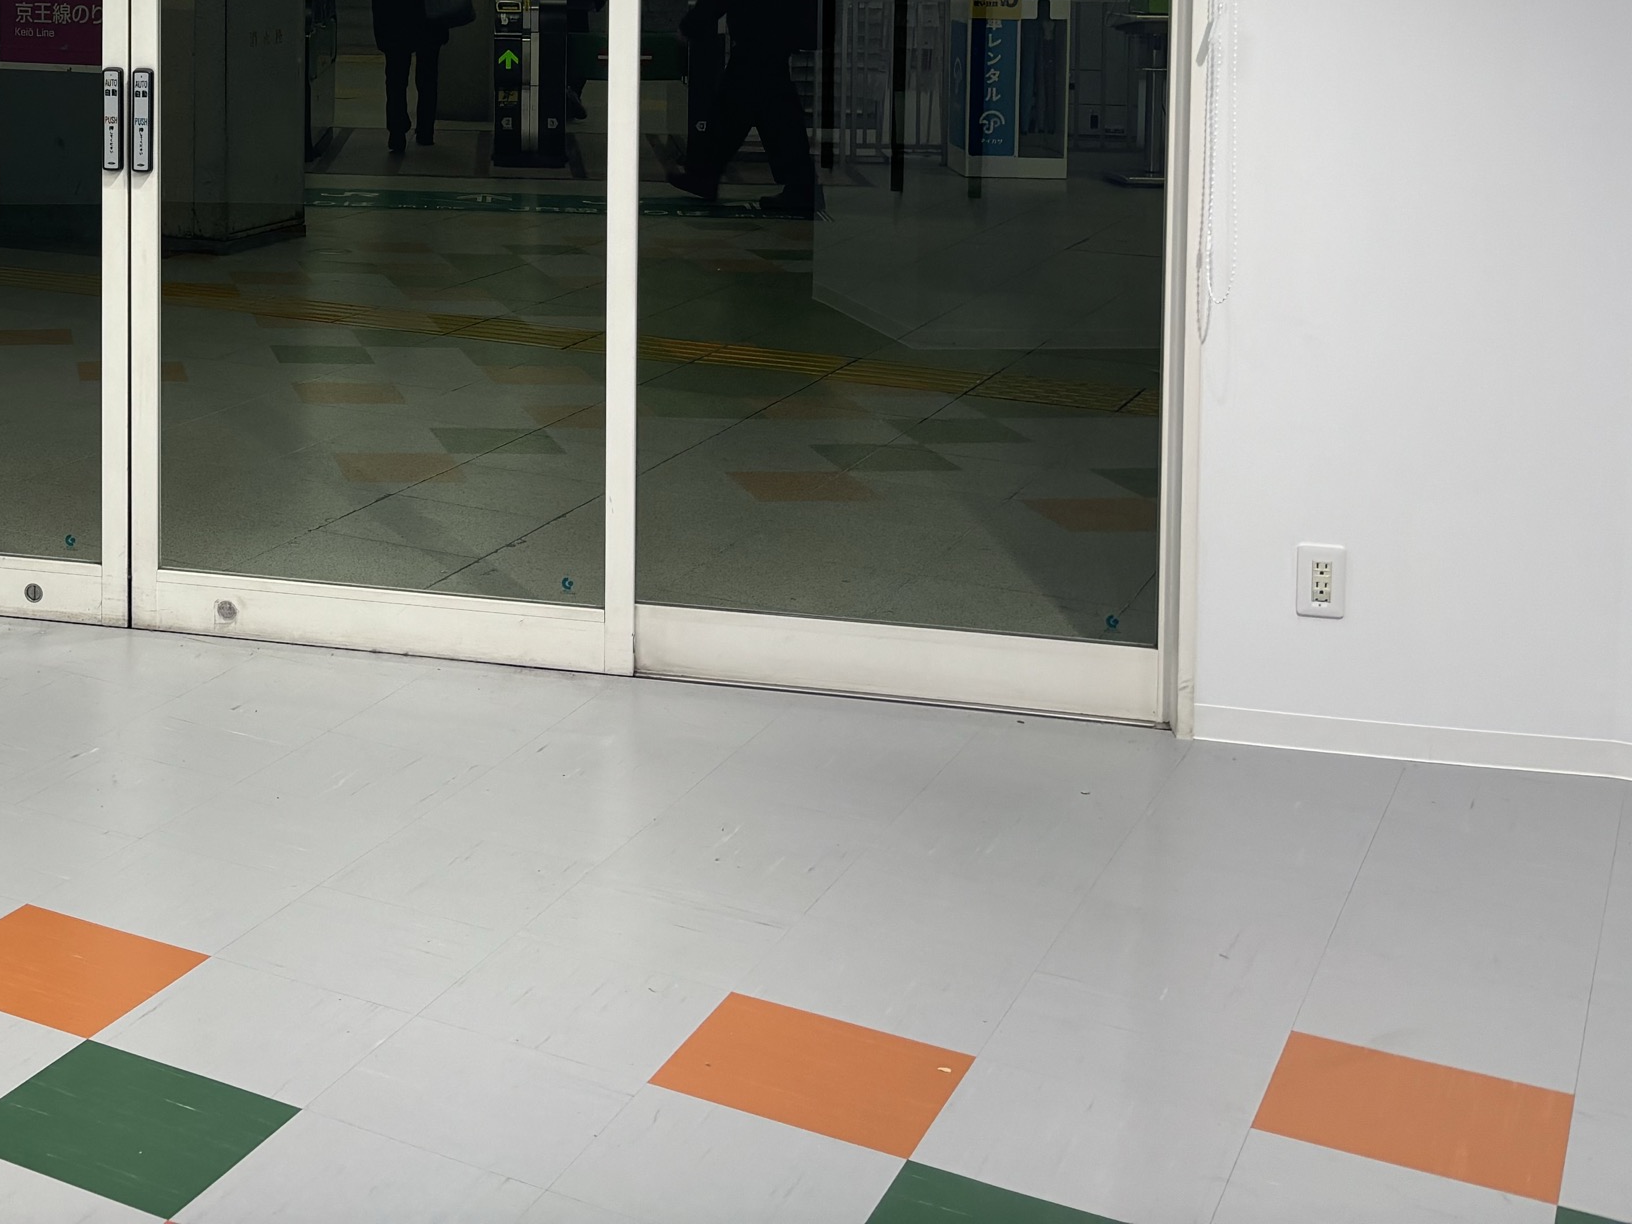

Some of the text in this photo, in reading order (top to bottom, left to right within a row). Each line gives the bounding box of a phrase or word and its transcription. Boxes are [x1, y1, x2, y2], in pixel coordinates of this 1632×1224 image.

[15, 1, 103, 25] 京王線のり
[36, 28, 55, 38] Line
[105, 78, 117, 87] AUTO
[135, 80, 148, 88] AUTO
[105, 88, 118, 97] 自動
[135, 90, 148, 98] 自動
[105, 115, 118, 124] PUSH
[135, 117, 148, 126] PUSH
